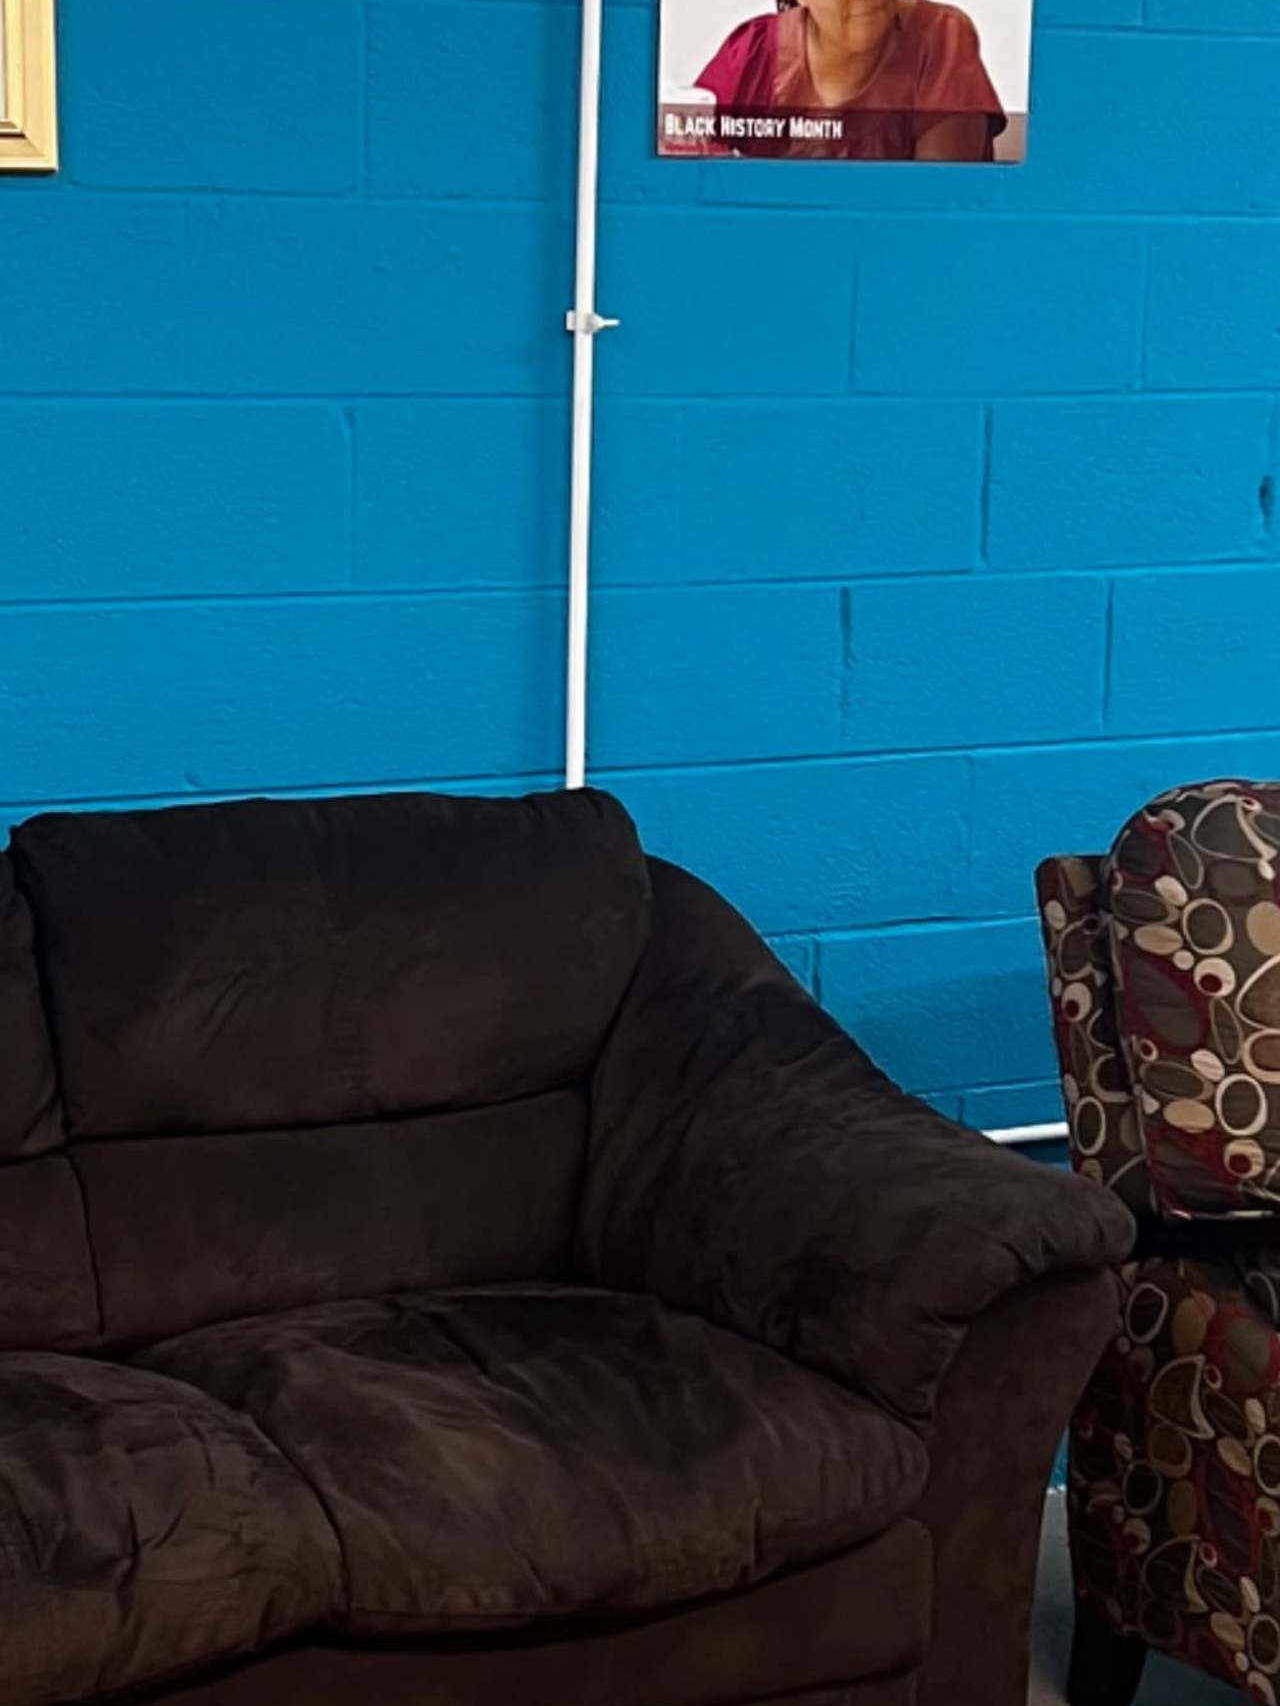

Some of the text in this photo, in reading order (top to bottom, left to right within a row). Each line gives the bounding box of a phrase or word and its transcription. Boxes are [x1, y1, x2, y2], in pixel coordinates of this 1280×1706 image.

[664, 113, 843, 139] BLACK HISTORY MONTH
